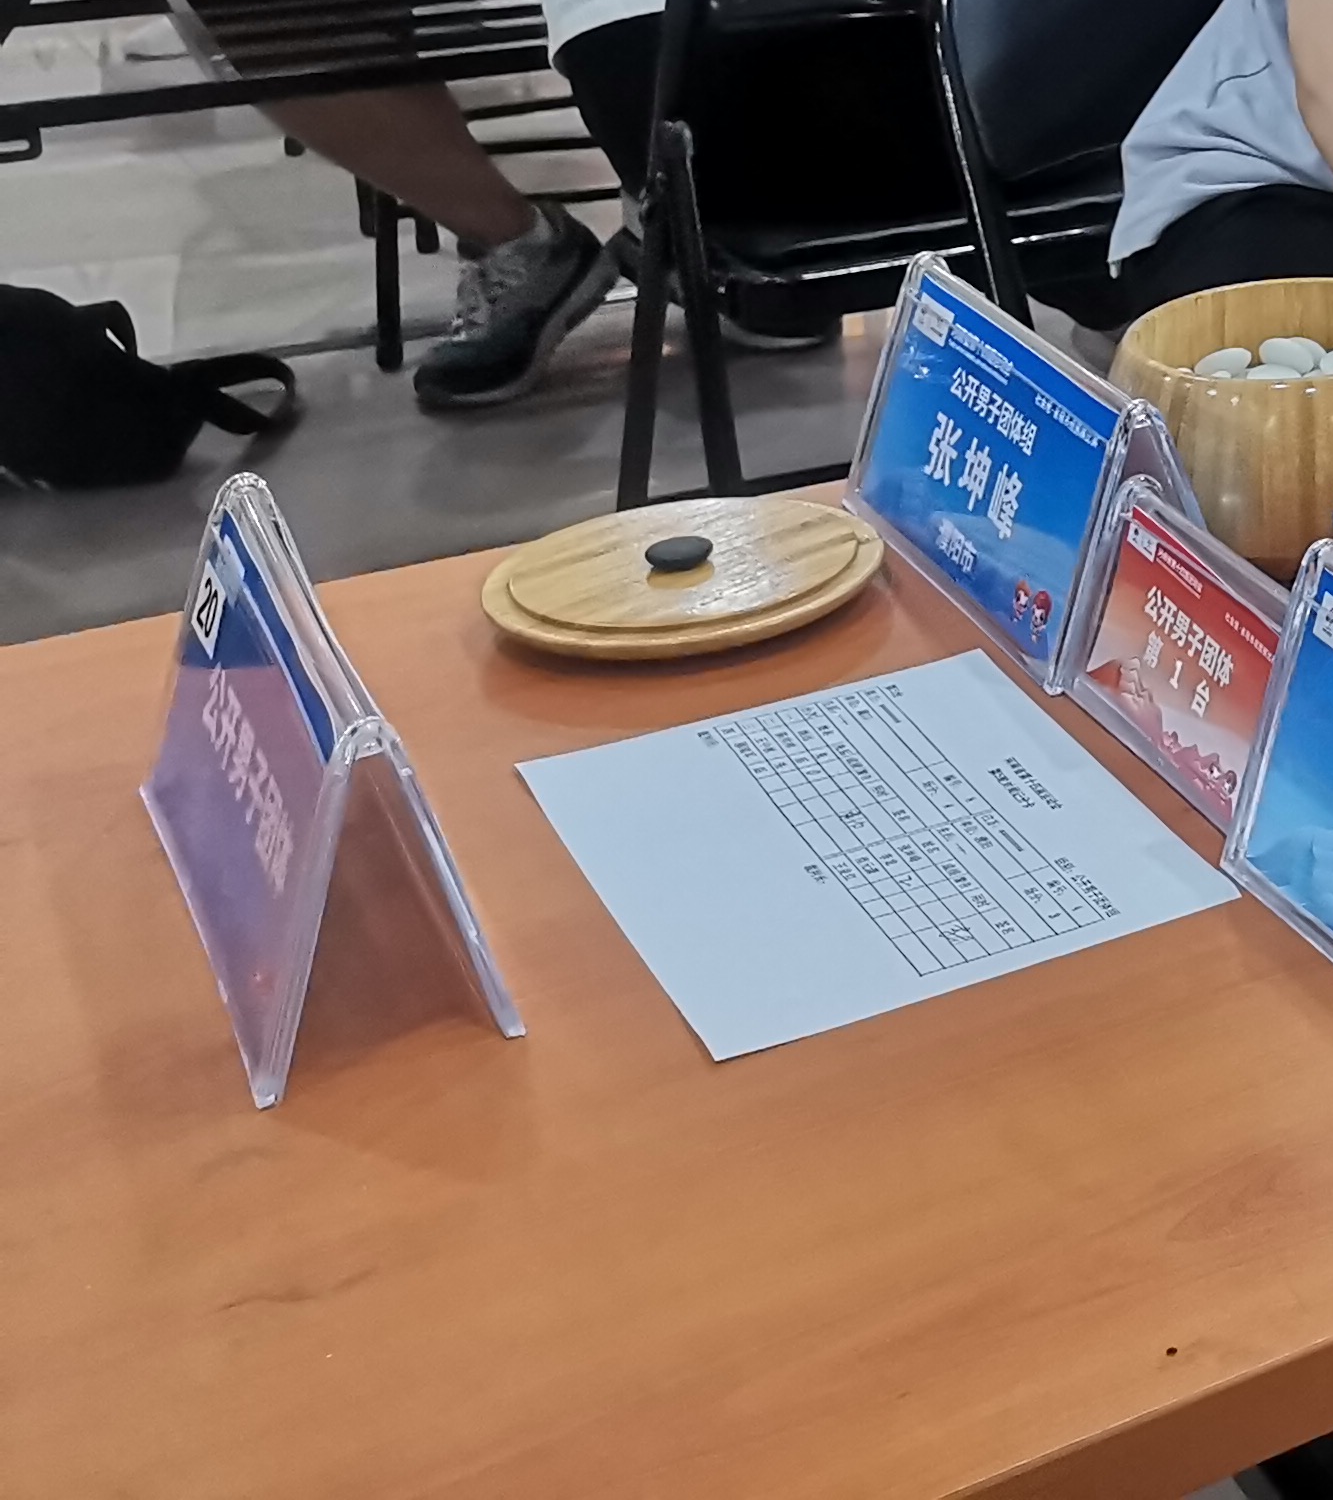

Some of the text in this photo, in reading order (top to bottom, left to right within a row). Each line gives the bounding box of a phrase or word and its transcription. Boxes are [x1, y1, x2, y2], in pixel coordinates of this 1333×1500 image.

[950, 366, 1038, 457] 公开男子团体组
[920, 411, 1023, 540] 张坤峰
[195, 574, 220, 639] 20
[1143, 585, 1235, 688] 公开男子团体
